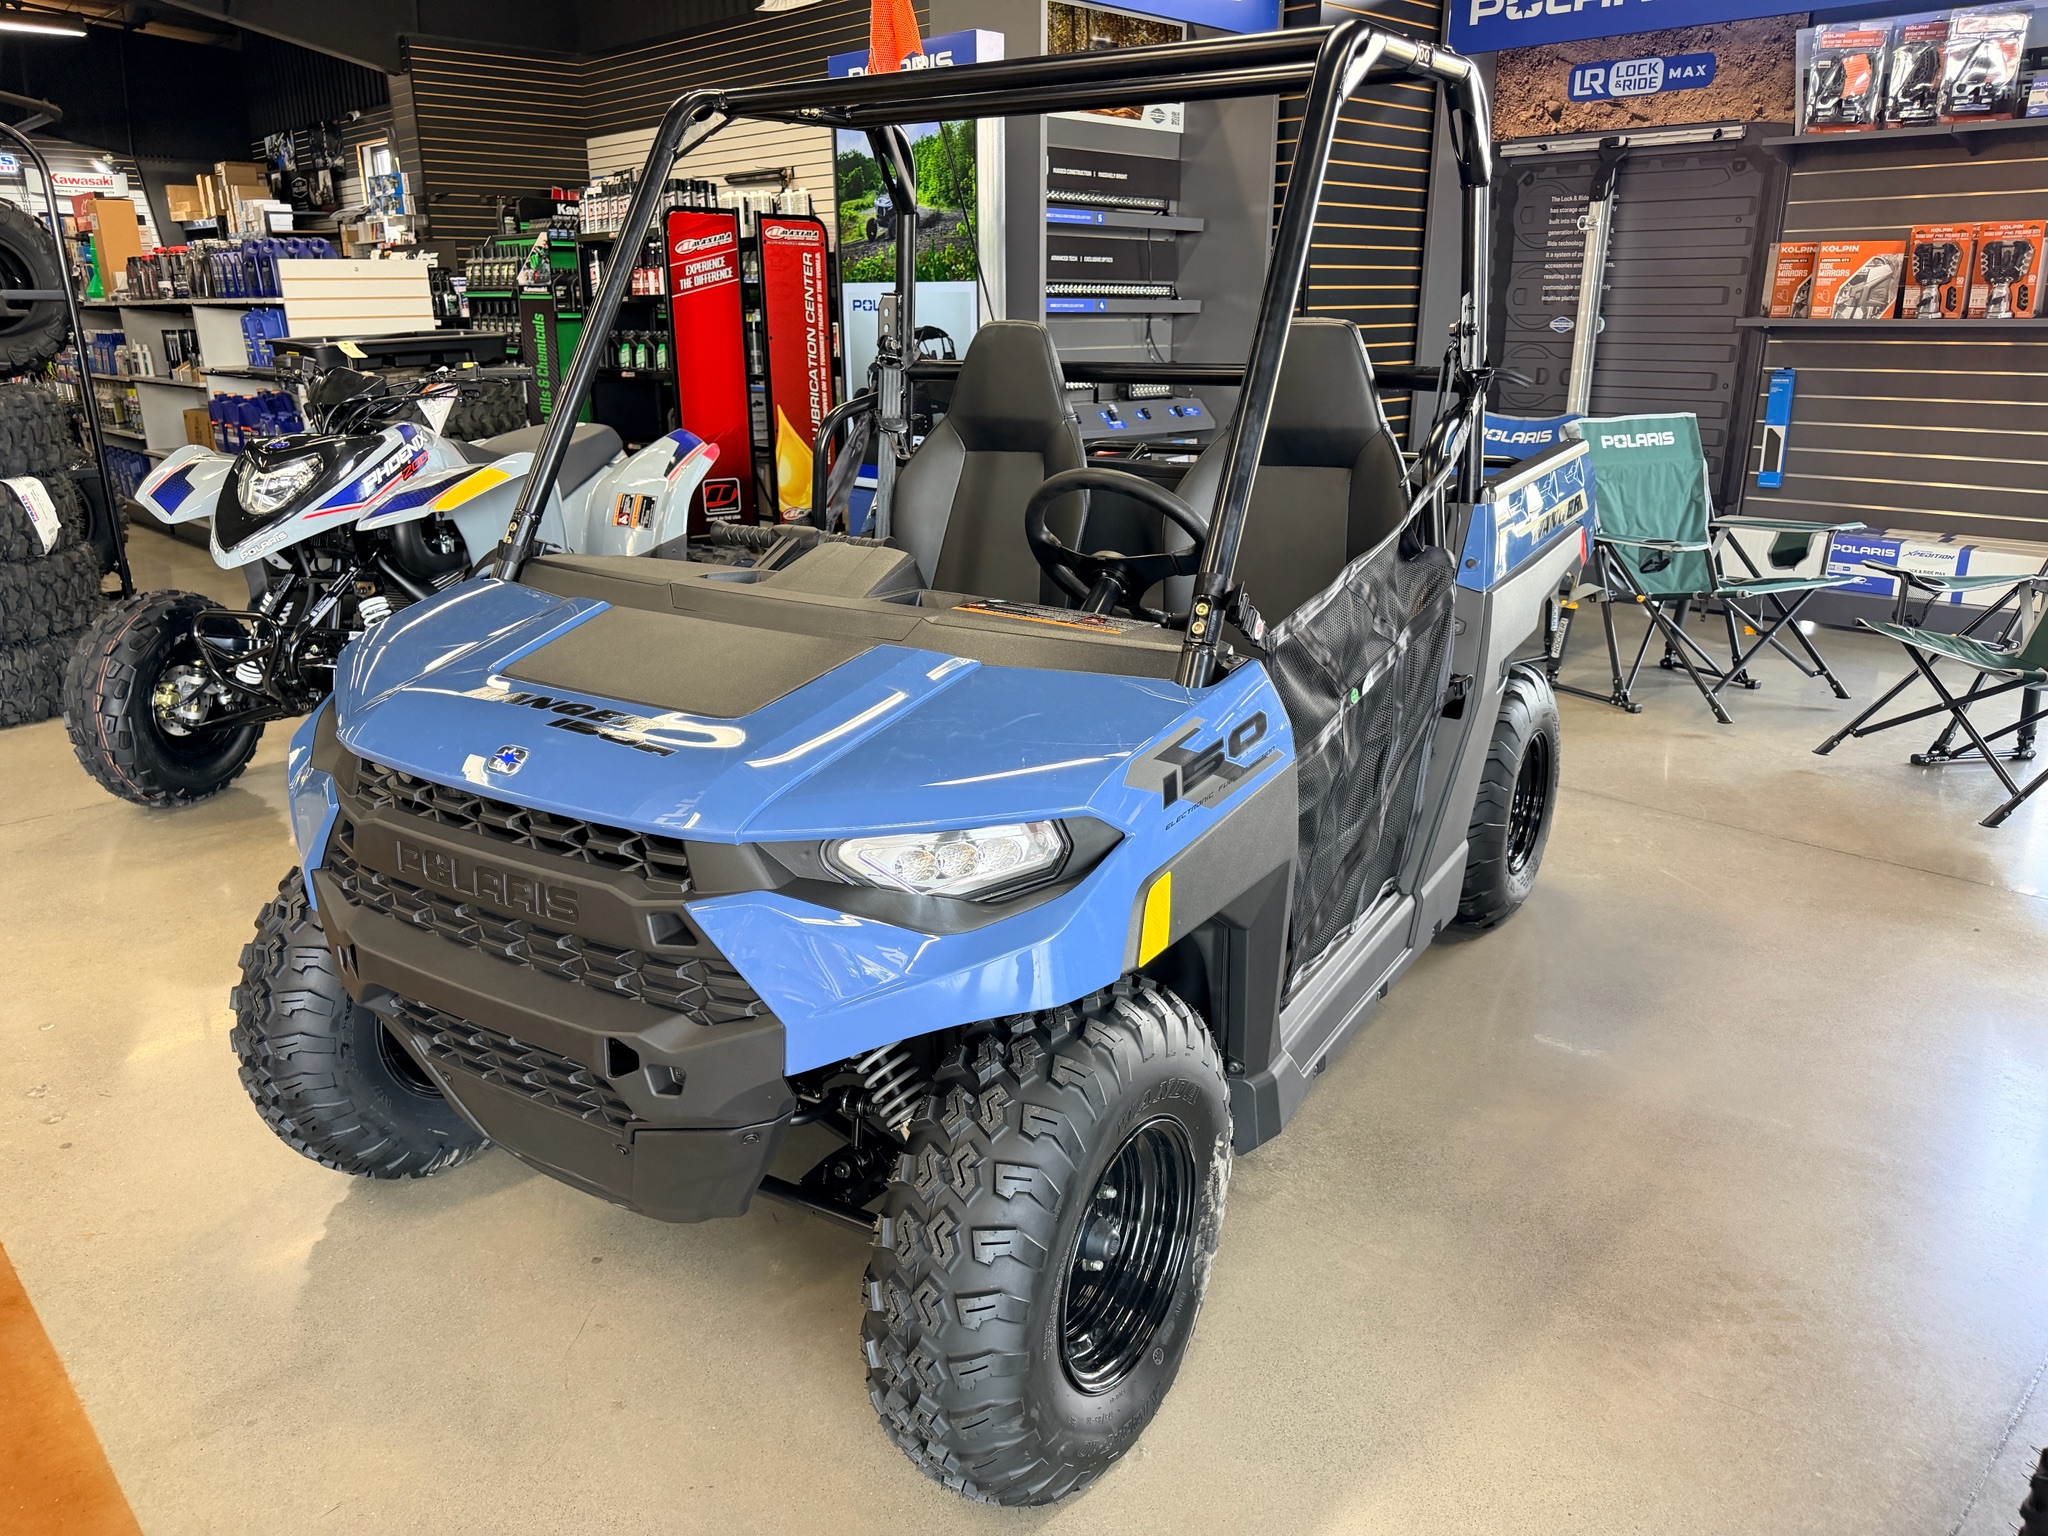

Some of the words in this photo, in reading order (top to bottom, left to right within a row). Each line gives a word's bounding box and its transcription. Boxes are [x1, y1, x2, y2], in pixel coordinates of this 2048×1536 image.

[1615, 62, 1659, 78] LOCK
[1668, 64, 1707, 80] MAX
[1573, 67, 1605, 96] LR
[1098, 214, 1103, 222] 5
[1559, 207, 1577, 215] storage
[691, 232, 733, 248] MAXIMA
[1558, 240, 1584, 249] technology
[1554, 252, 1571, 260] system
[685, 256, 726, 276] EXPERIENCE
[1778, 263, 1793, 271] SIDE
[1817, 269, 1850, 277] MIRRORS
[1819, 262, 1834, 270] SIDE
[679, 277, 693, 291] THE
[693, 266, 734, 287] DIFFERENCE
[802, 252, 816, 324] CENTER
[1099, 301, 1105, 310] 4
[532, 312, 549, 377] Chemicals
[806, 326, 822, 441] UBRICATION
[1601, 431, 1675, 449] POLARIS
[360, 431, 429, 498] PHOENIX
[402, 451, 429, 481] 200
[239, 531, 288, 561] POLARIS
[1832, 543, 1896, 557] POLARIS
[1903, 550, 1956, 561] XPEDITION
[1165, 790, 1215, 831] ELECTRONIC
[1217, 776, 1237, 793] FUEL
[396, 840, 580, 926] POLARIS
